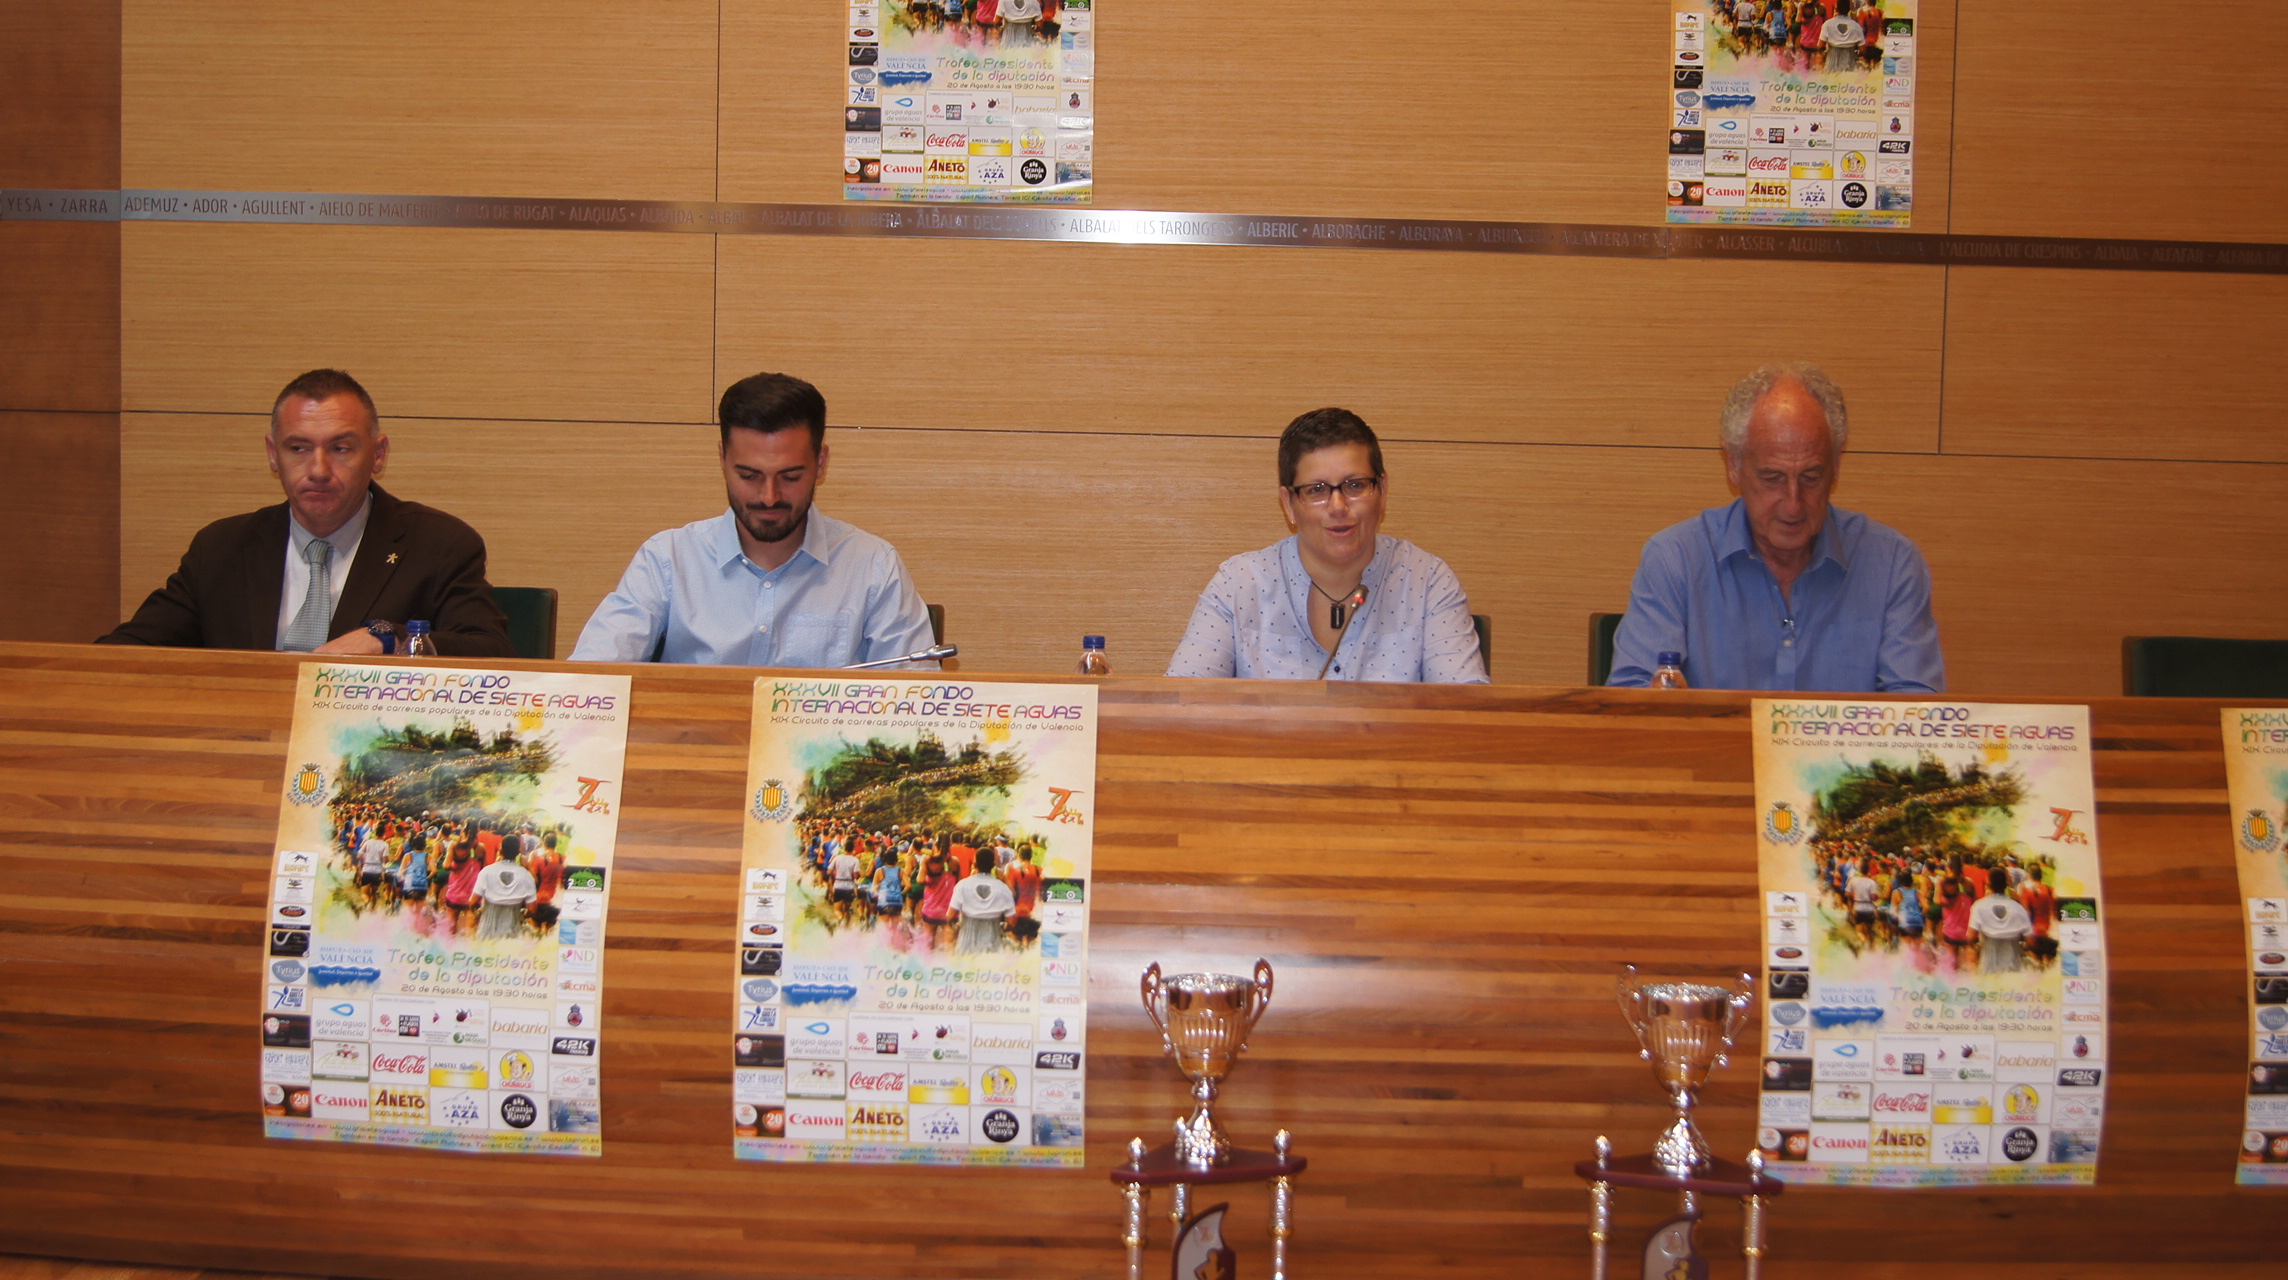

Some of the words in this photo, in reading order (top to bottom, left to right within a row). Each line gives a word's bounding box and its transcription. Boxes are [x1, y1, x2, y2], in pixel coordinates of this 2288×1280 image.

[936, 57, 980, 69] Trofeo
[983, 58, 1054, 70] Presidente
[952, 69, 968, 80] de
[972, 70, 984, 81] la
[988, 70, 1055, 83] diputación
[1760, 81, 1803, 92] Trofeo
[1806, 82, 1877, 94] Presidente
[1775, 93, 1791, 104] de
[1795, 94, 1806, 104] la
[1810, 94, 1876, 107] diputación
[926, 133, 966, 148] Coca-Cola
[1836, 129, 1877, 140] babaria
[1881, 141, 1907, 151] 42K
[883, 164, 923, 174] Canon
[1748, 155, 1789, 171] Coca-Cola
[1706, 187, 1745, 197] Canon
[1750, 182, 1787, 196] ANETO
[7, 196, 42, 213] YESA
[60, 197, 109, 214] ZARRA
[124, 196, 180, 213] ADEMUZ
[192, 198, 229, 214] ADOR
[241, 199, 306, 216] AGULLENT
[318, 201, 354, 217] AIELO
[358, 202, 375, 218] DE
[492, 205, 510, 221] DE
[513, 205, 557, 221] RUGAT
[568, 206, 627, 225] ALAQUAS
[816, 211, 834, 227] DE
[837, 212, 852, 227] LA
[916, 213, 970, 230] ALBALAT
[1127, 218, 1156, 234] ELS
[1160, 219, 1235, 237] TARONGERS
[1247, 221, 1299, 238] ALBERIC
[1311, 223, 1386, 240] ALBORACHE
[1398, 225, 1464, 242] ALBORAYA
[1716, 234, 1776, 252] ALCASSER
[2004, 242, 2022, 259] DE
[2024, 243, 2082, 260] CRESPINS
[315, 667, 382, 684] XXXVII
[385, 671, 438, 686] GRAN
[444, 674, 510, 689] FONDO
[314, 684, 455, 703] INTERNACIONAL
[459, 690, 488, 704] DE
[489, 691, 546, 707] SIETE
[548, 695, 616, 710] AGUAS
[772, 682, 841, 697] XXXVII
[845, 684, 898, 699] GRAN
[905, 685, 973, 701] FONDO
[312, 701, 332, 709] XIX
[333, 702, 369, 711] Circuito
[372, 703, 384, 711] de
[387, 705, 426, 713] carreras
[428, 706, 476, 715] populares
[479, 707, 491, 716] de
[493, 708, 502, 717] la
[504, 709, 556, 719] Diputación
[559, 710, 571, 719] de
[574, 712, 616, 722] Valencia
[771, 698, 918, 716] INTERNACIONAL
[921, 702, 950, 717] DE
[952, 703, 1012, 718] SIETE
[1013, 704, 1083, 720] AGUAS
[1771, 704, 1838, 718] XXXVII
[1842, 705, 1896, 720] GRAN
[1903, 707, 1969, 721] FONDO
[770, 715, 790, 724] XIX
[792, 716, 830, 725] Circuito
[832, 717, 844, 725] de
[847, 718, 888, 726] carreras
[891, 718, 940, 728] populares
[943, 719, 955, 727] de
[957, 719, 967, 728] la
[969, 720, 1022, 731] Diputación
[1025, 721, 1038, 730] de
[1041, 722, 1084, 731] Valencia
[1771, 721, 1916, 737] INTERNACIONAL
[1920, 723, 1948, 738] DE
[1950, 724, 2007, 738] SIETE
[2009, 725, 2076, 740] AGUAS
[388, 948, 446, 965] Trofeo
[452, 952, 549, 970] Presidente
[409, 967, 430, 981] de
[436, 968, 451, 982] la
[457, 969, 549, 988] diputación
[864, 965, 924, 981] Trofeo
[931, 967, 1032, 984] Presidente
[401, 983, 416, 992] 20
[418, 984, 430, 993] de
[433, 986, 466, 995] Agosto
[476, 987, 490, 996] las
[522, 990, 548, 999] horas
[886, 983, 908, 998] de
[915, 984, 930, 998] la
[937, 985, 1031, 1003] diputación
[1890, 987, 1949, 1002] Trofeo
[1955, 987, 2053, 1004] Presidente
[878, 1000, 893, 1009] 20
[896, 1001, 908, 1009] de
[910, 1002, 944, 1012] Agosto
[1003, 1005, 1030, 1013] horas
[1912, 1003, 1935, 1018] de
[1940, 1004, 1955, 1018] la
[491, 1019, 549, 1035] babaria
[555, 1038, 591, 1051] 42K
[972, 1035, 1031, 1050] babaria
[372, 1053, 428, 1076] Coca-Cola
[1039, 1053, 1076, 1065] 42K
[849, 1071, 906, 1092] Coca-Cola
[2061, 1070, 2097, 1082] 42K
[314, 1093, 368, 1109] Canon
[374, 1089, 426, 1110] ANETO
[450, 1109, 480, 1119] AZA
[504, 1104, 534, 1116] Granja
[851, 1107, 904, 1126] ANETO
[789, 1112, 844, 1127] Canon
[931, 1125, 960, 1135] AZA
[1812, 1135, 1868, 1149] Canon
